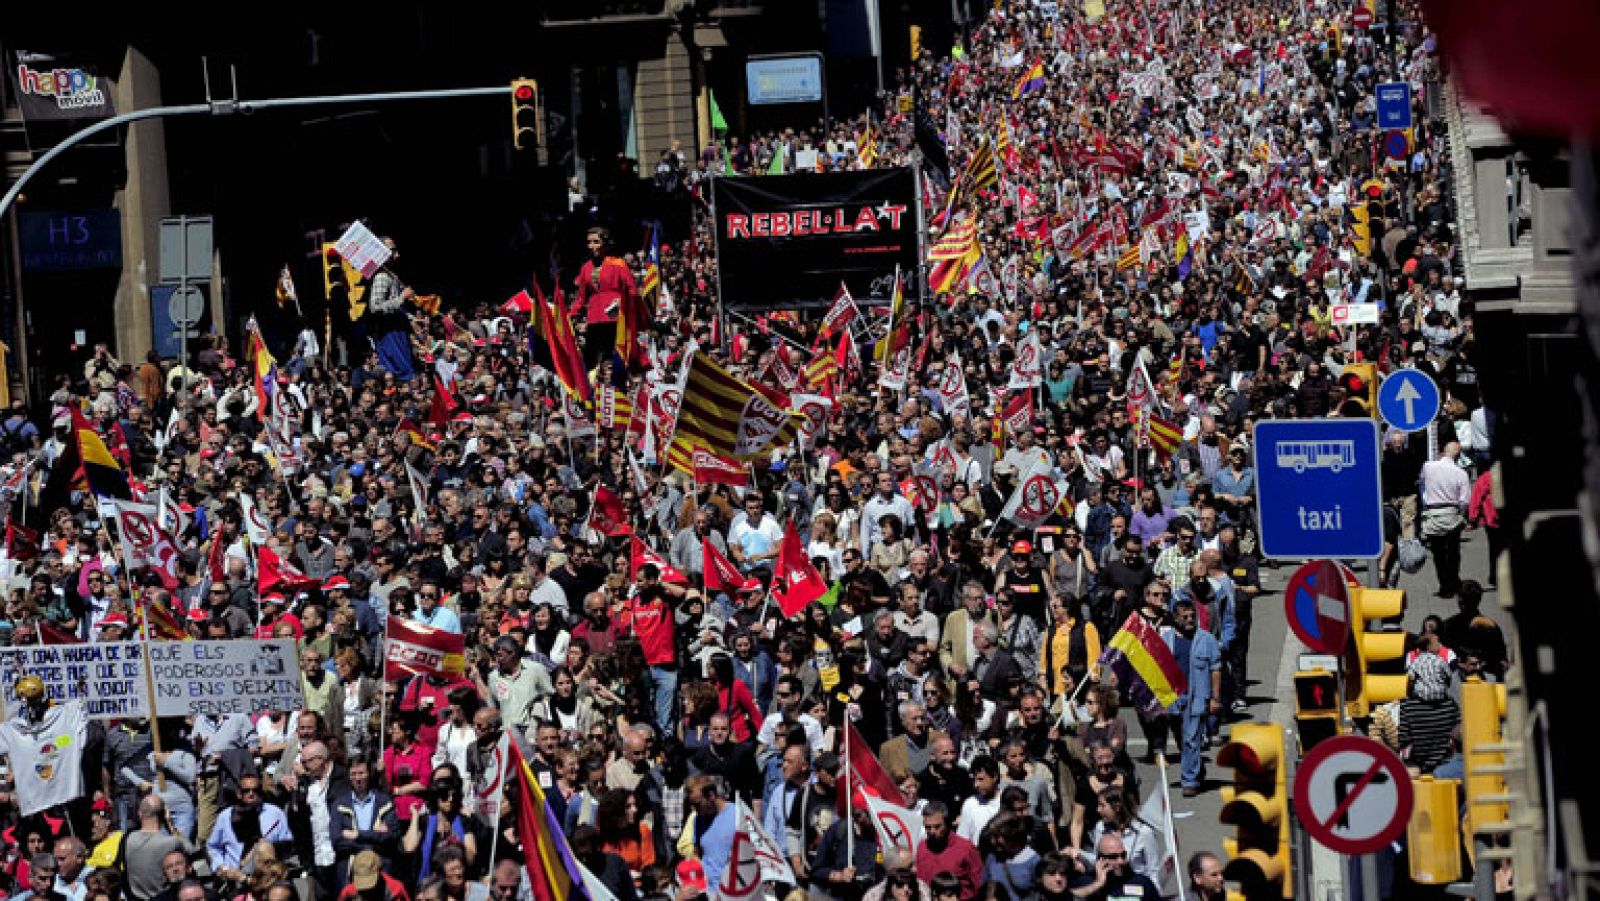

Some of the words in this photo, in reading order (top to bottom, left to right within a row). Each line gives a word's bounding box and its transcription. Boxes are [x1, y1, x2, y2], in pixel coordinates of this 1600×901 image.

[19, 64, 96, 97] happy
[49, 216, 90, 245] H3
[1297, 505, 1342, 530] taxi
[150, 644, 181, 661] QUE
[193, 644, 225, 660] ELS
[153, 662, 245, 680] PODEROSOS
[158, 683, 181, 698] NO
[188, 681, 225, 697] ENS
[233, 679, 300, 696] DEIXIN
[189, 698, 241, 715] SENSE
[251, 697, 303, 712] DRETS
